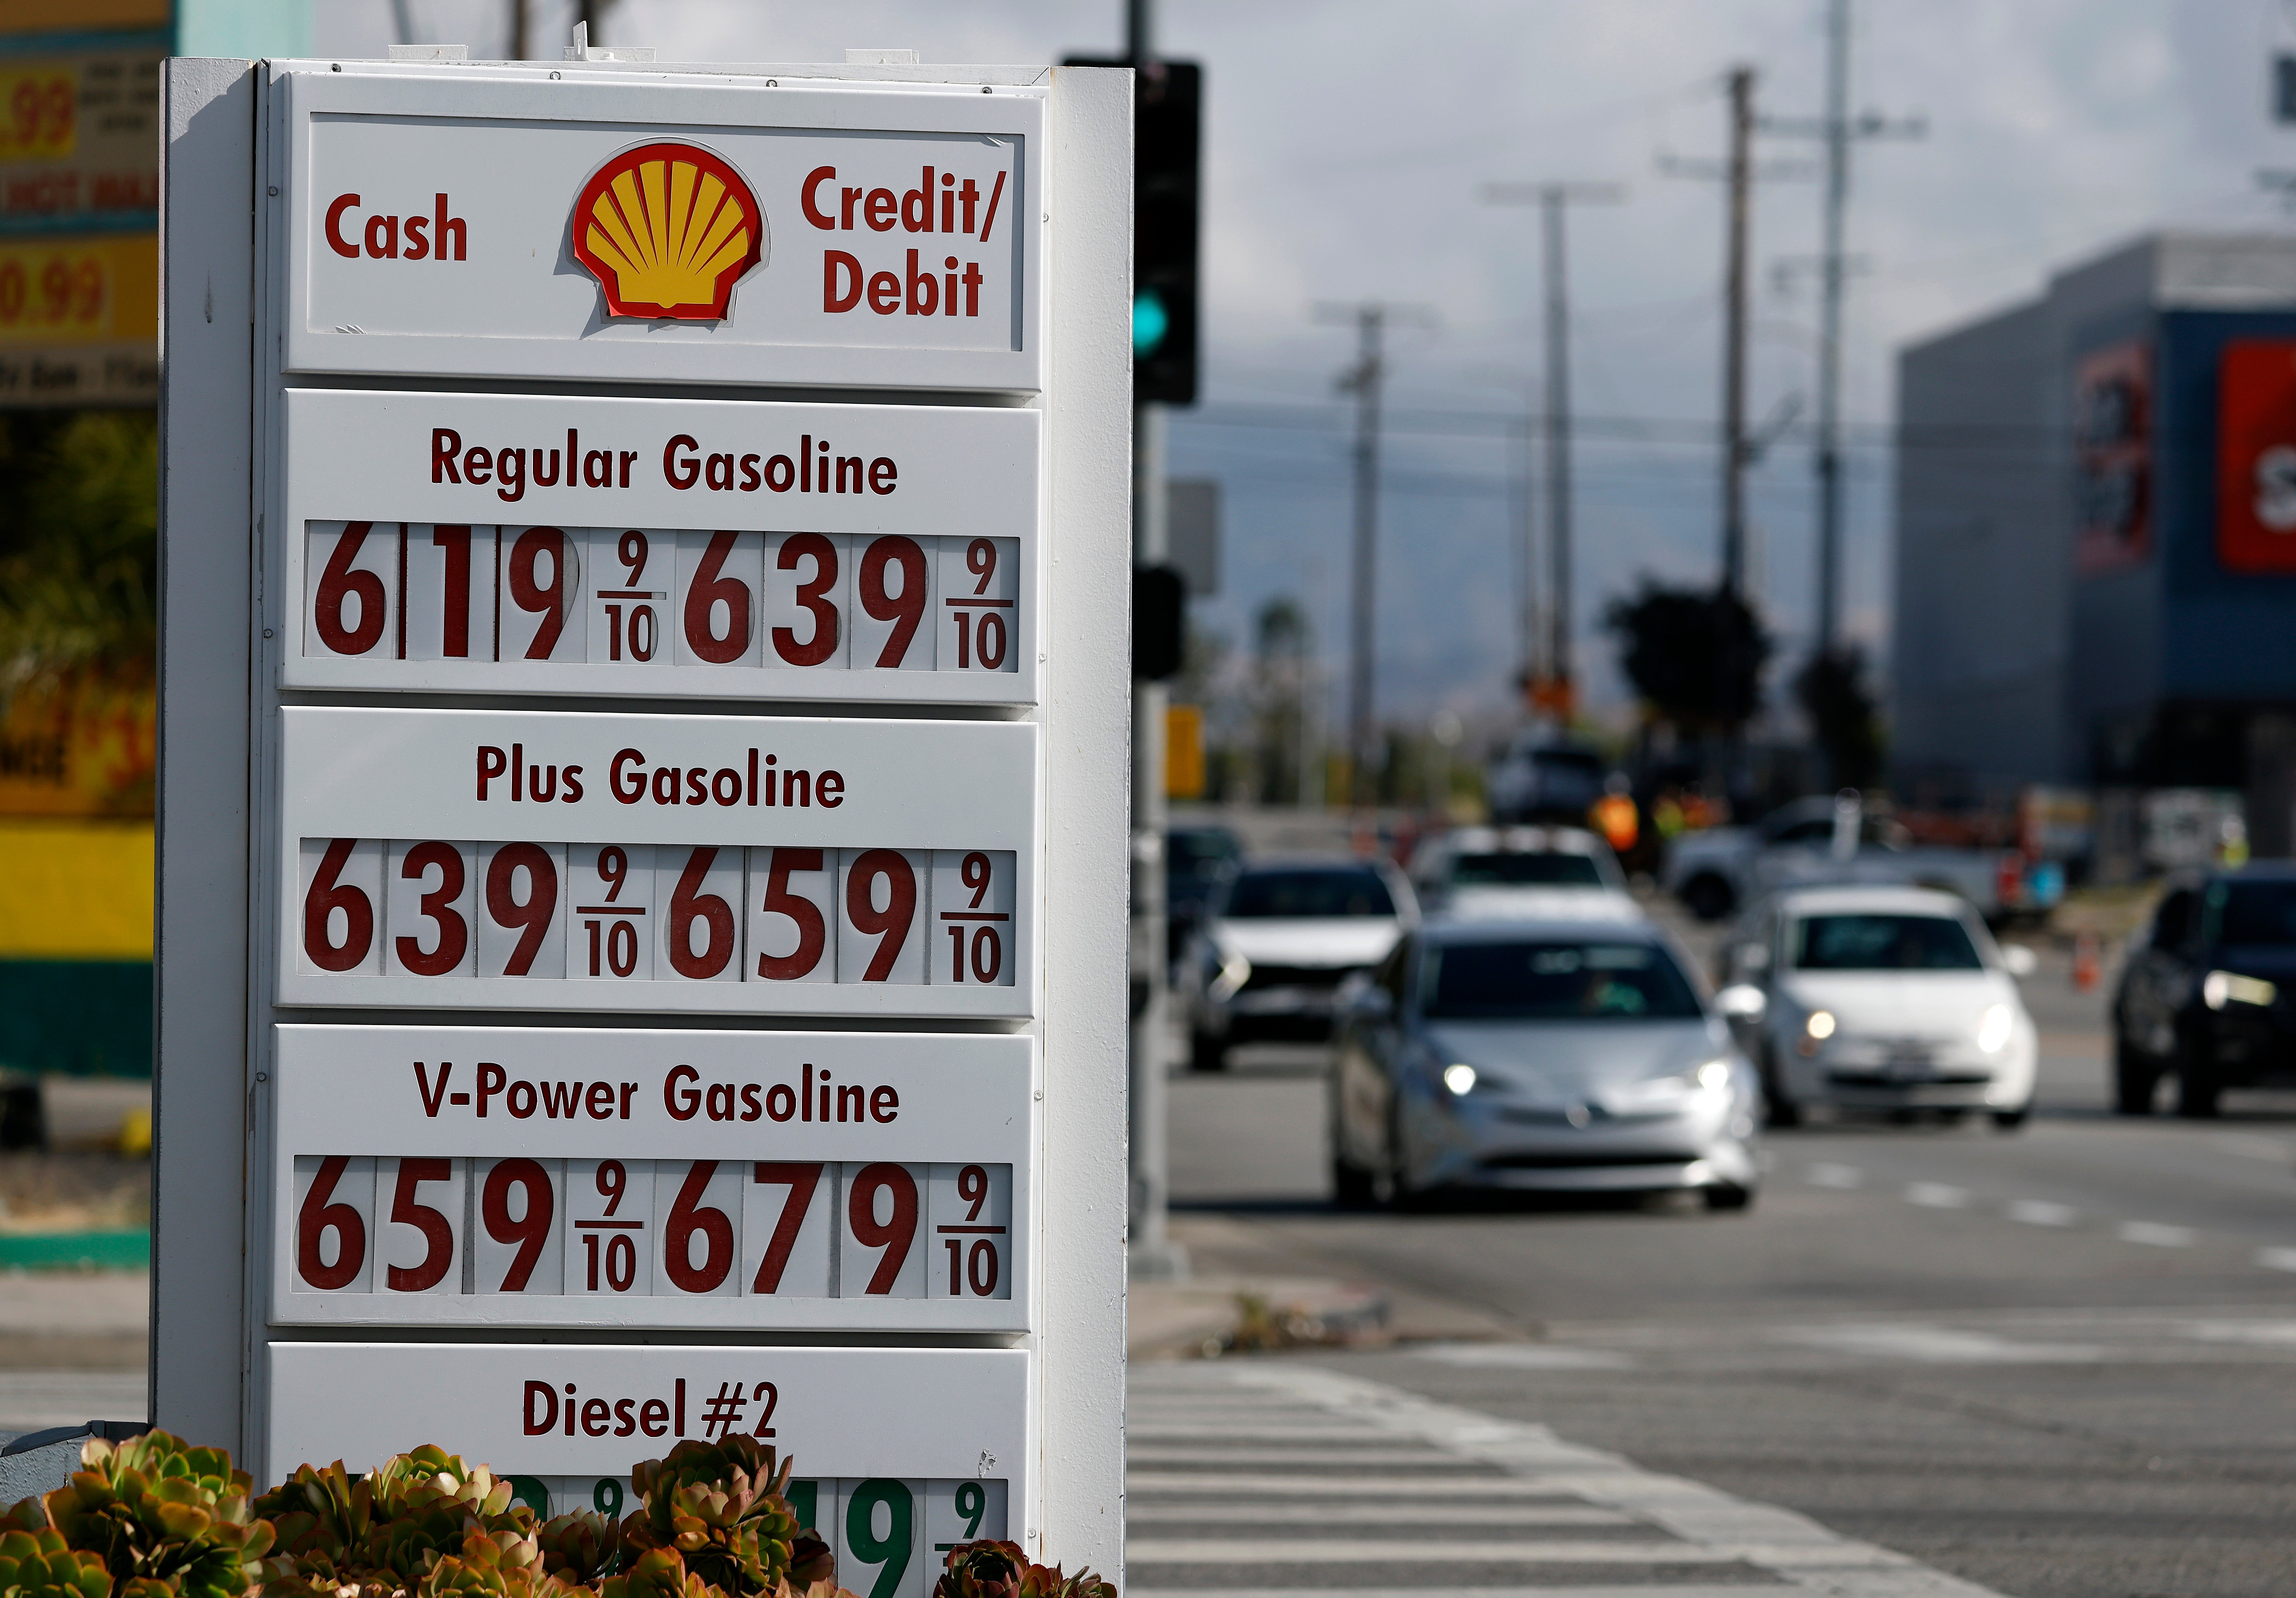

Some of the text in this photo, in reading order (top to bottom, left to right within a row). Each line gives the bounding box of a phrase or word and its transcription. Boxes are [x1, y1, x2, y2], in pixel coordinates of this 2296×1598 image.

[325, 193, 468, 261] Cash
[801, 165, 1006, 243] Credit/
[824, 248, 983, 317] Debit
[430, 429, 897, 503] Regular Gasoline
[315, 521, 577, 660] 619
[683, 530, 929, 668] 639
[476, 744, 844, 809] Plus Gasoline
[304, 838, 558, 976] 639
[668, 847, 917, 982] 659
[413, 1062, 898, 1125] V-Power Gasoline
[297, 1155, 555, 1293] 659
[664, 1160, 920, 1295] 679
[522, 1378, 778, 1440] Diesel #2
